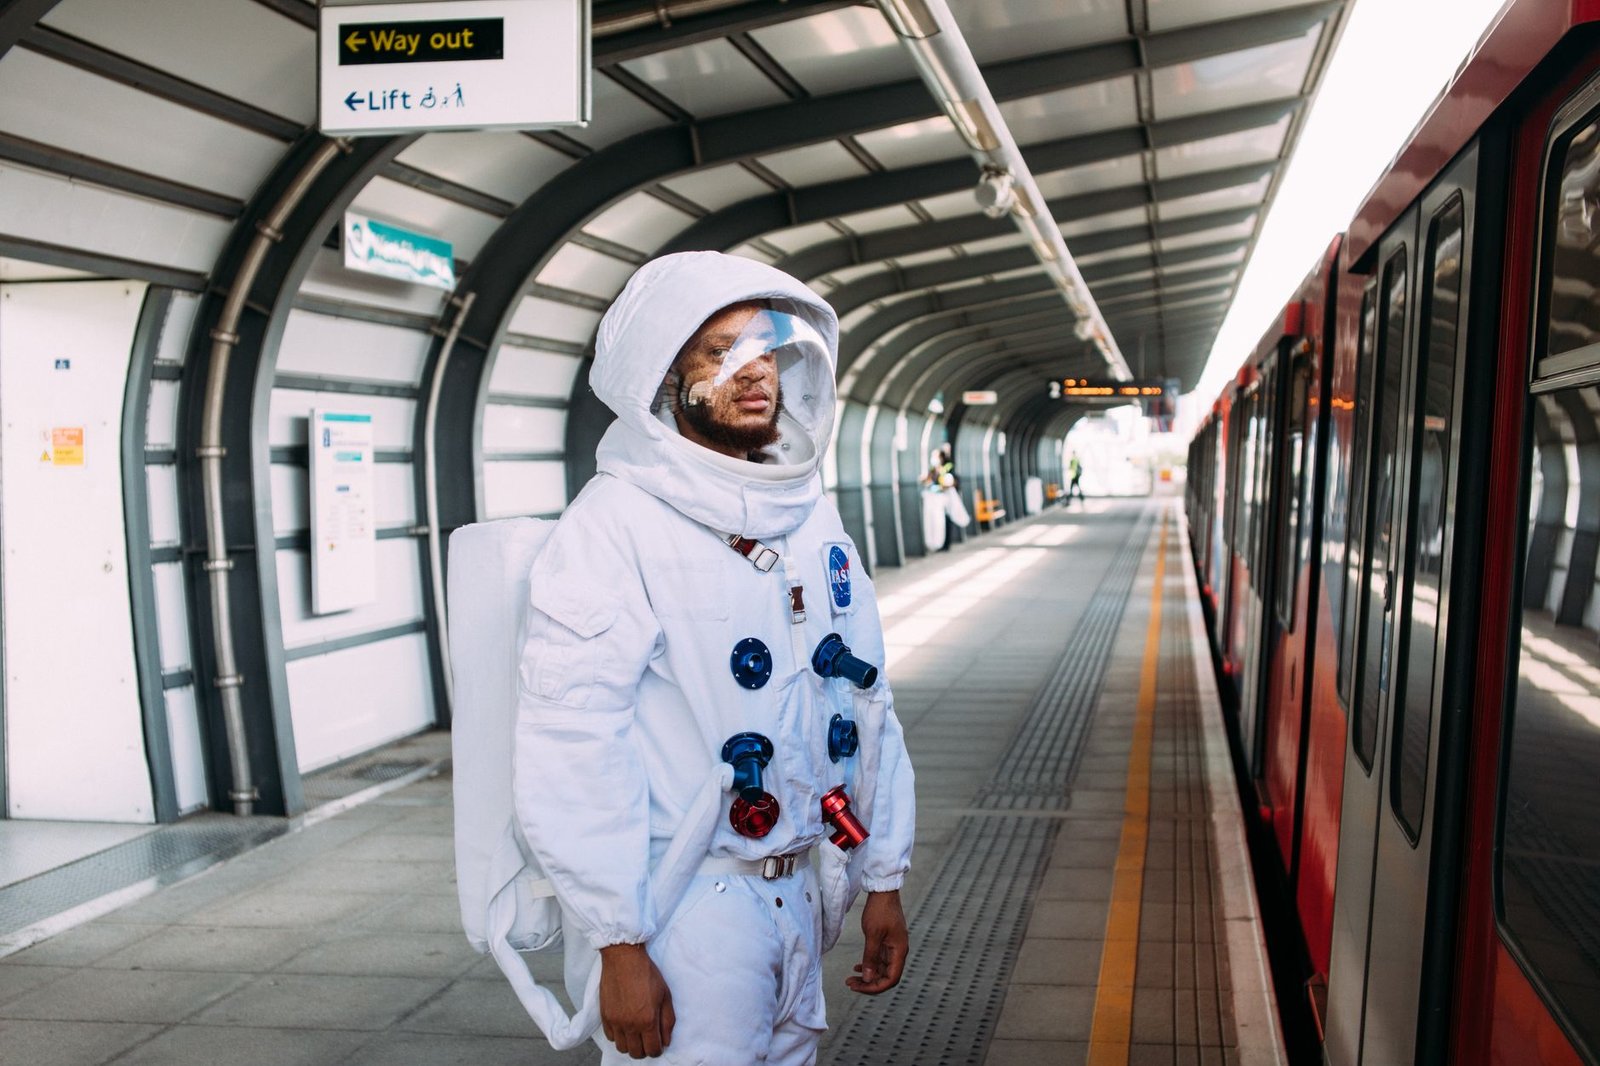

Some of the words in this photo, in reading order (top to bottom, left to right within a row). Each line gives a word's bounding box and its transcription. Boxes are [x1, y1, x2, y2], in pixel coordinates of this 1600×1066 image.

[370, 31, 420, 55] Way
[430, 29, 474, 50] out
[369, 89, 411, 111] Lift
